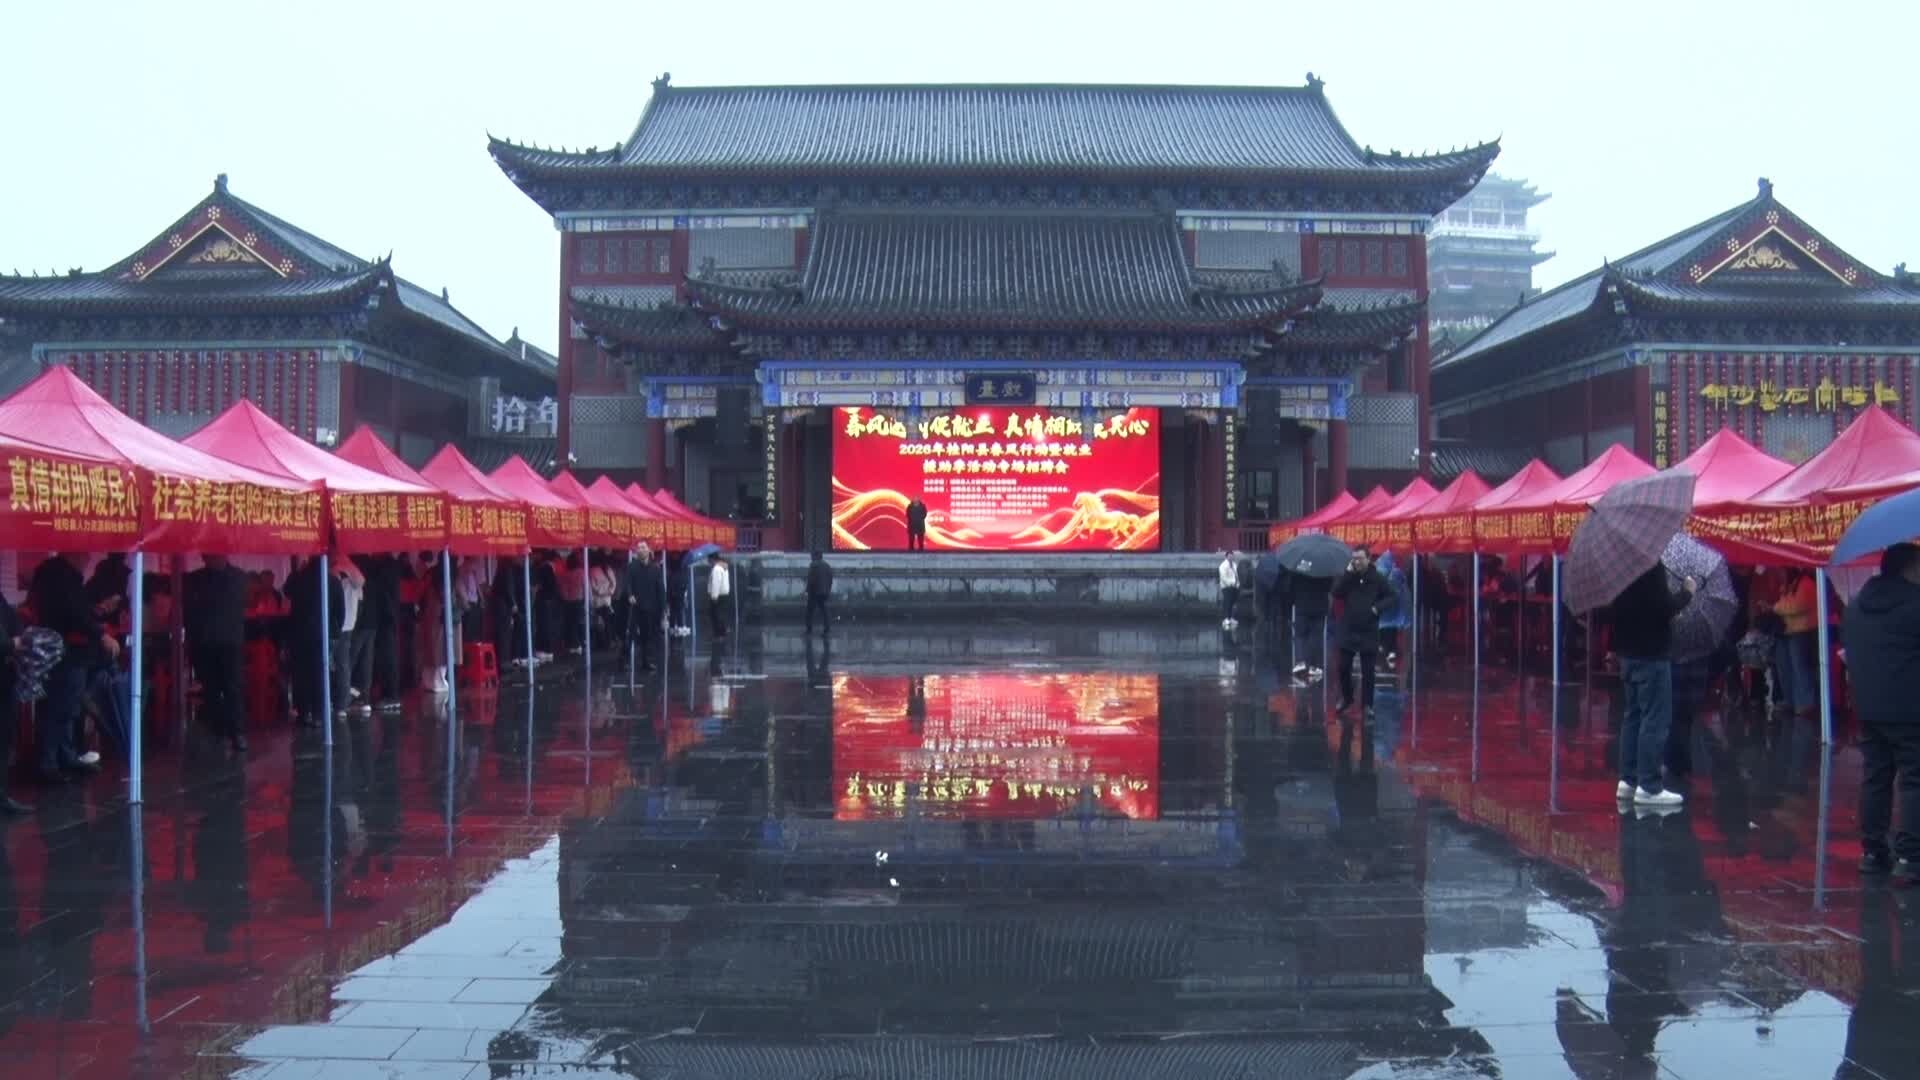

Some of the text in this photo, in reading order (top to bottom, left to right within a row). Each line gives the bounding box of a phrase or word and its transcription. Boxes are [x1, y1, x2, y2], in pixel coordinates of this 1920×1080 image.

[8, 456, 141, 514] 真情相助暖民心
[152, 472, 321, 528] 社会养老保险政策宣传
